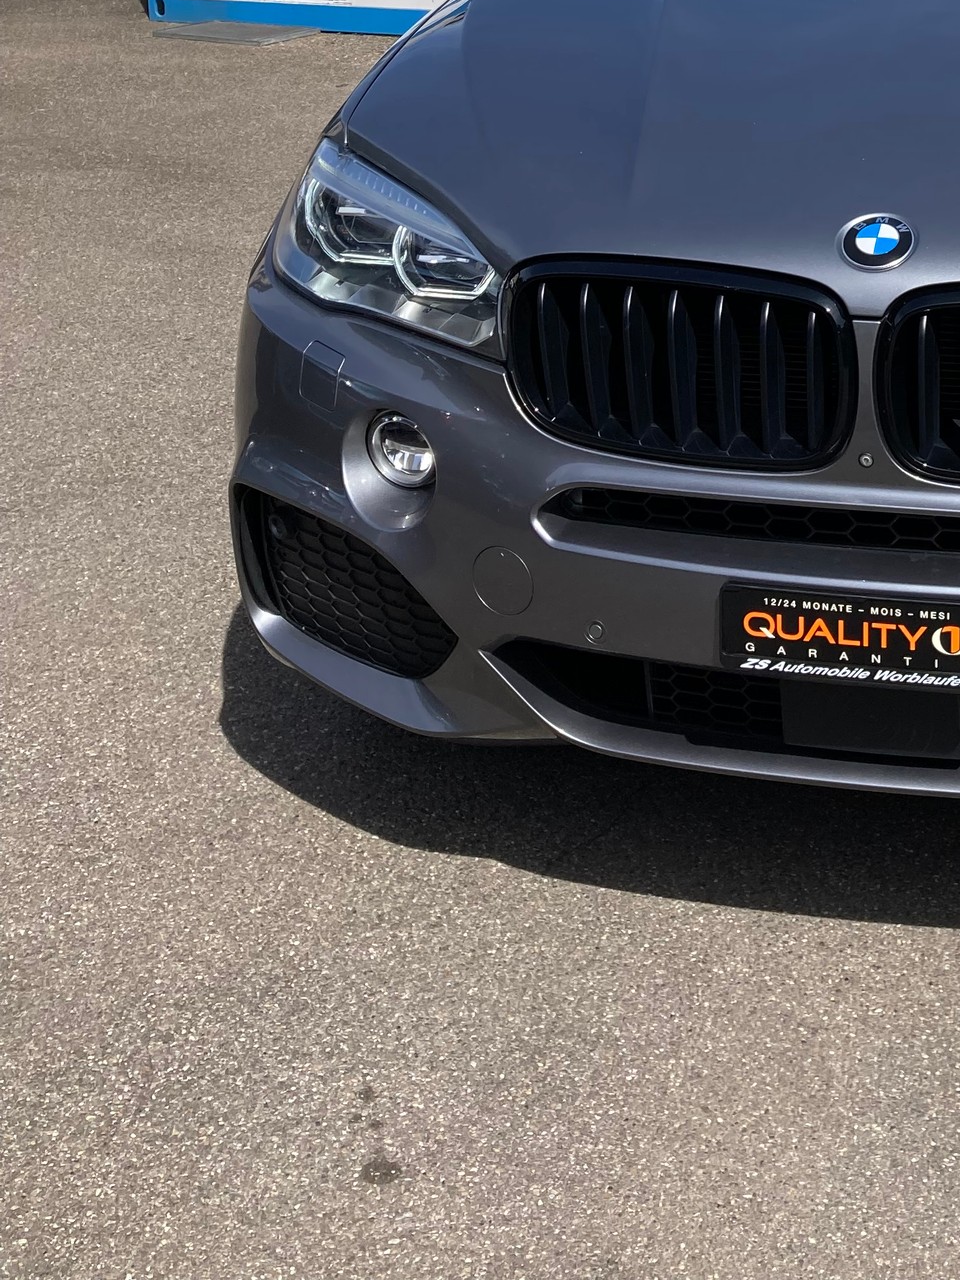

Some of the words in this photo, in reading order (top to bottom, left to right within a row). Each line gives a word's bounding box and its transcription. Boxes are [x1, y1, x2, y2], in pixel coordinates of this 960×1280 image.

[853, 217, 909, 233] BMW
[763, 597, 797, 608] 12/24
[802, 601, 853, 613] MONATE
[870, 606, 902, 617] MOIS
[920, 610, 950, 620] MESI
[743, 611, 928, 651] QUALITY
[740, 658, 772, 670] ZS
[769, 661, 871, 679] Automobile
